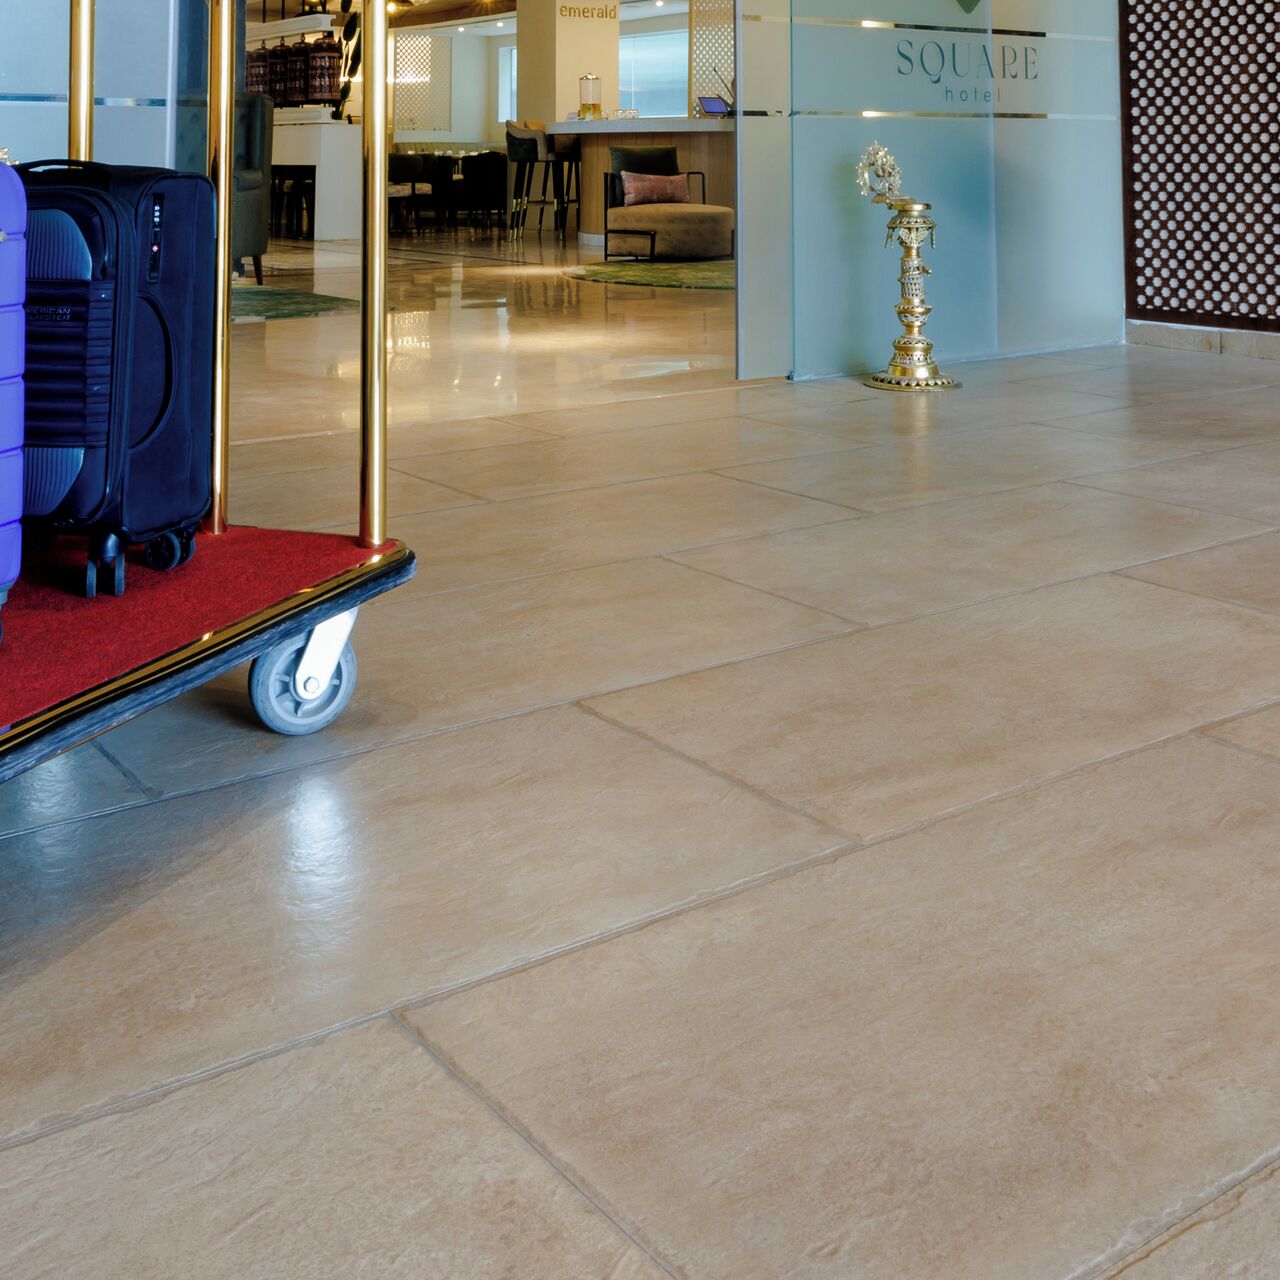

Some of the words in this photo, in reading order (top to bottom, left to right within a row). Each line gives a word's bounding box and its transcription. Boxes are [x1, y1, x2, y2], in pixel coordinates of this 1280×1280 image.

[559, 4, 617, 20] emerald
[896, 39, 1039, 85] SQUARE
[945, 86, 1001, 103] hotel
